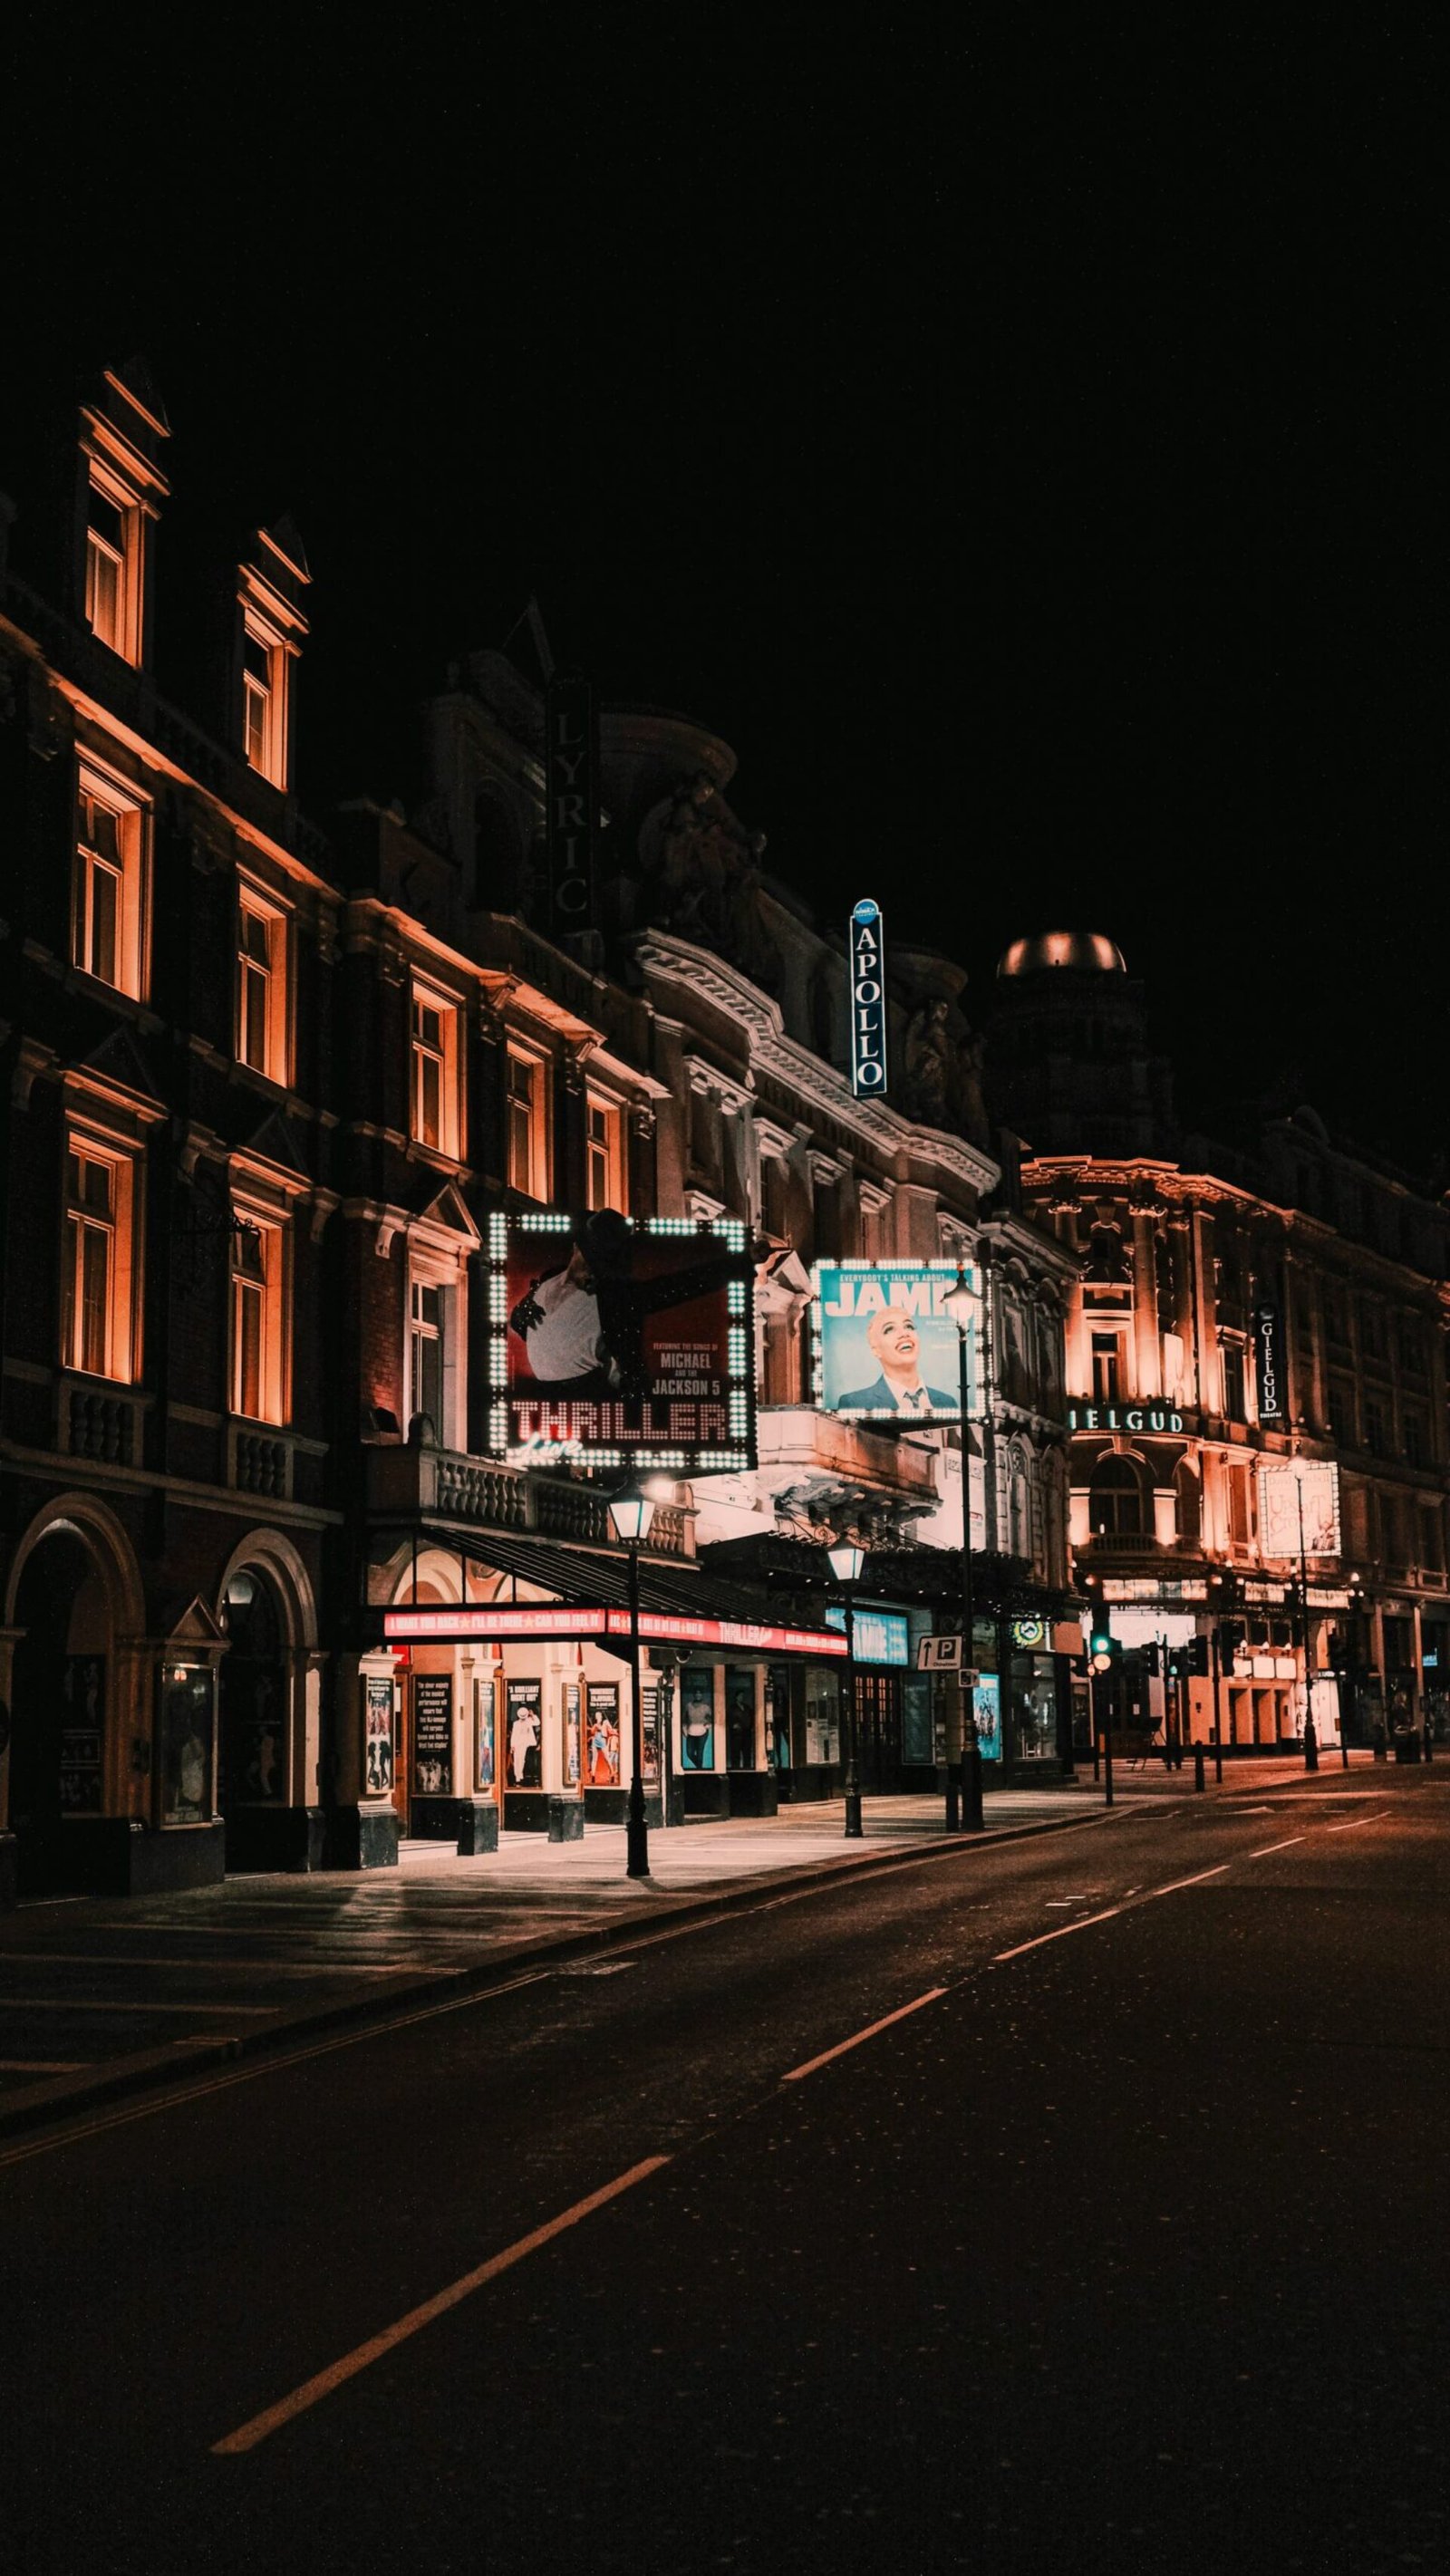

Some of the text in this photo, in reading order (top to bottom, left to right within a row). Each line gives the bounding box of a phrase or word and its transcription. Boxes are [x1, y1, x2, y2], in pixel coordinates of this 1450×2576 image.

[554, 713, 587, 913] LYRIC
[856, 928, 883, 1085] APOLLO
[891, 1274, 919, 1282] TALKING
[922, 1274, 944, 1282] ABOUT
[661, 1353, 711, 1368] MICHAEL
[1262, 1323, 1277, 1412] GIELGUD
[652, 1379, 720, 1395] JACKSON 5
[512, 1402, 725, 1441] THRILLER
[1069, 1408, 1183, 1433] IELGUD
